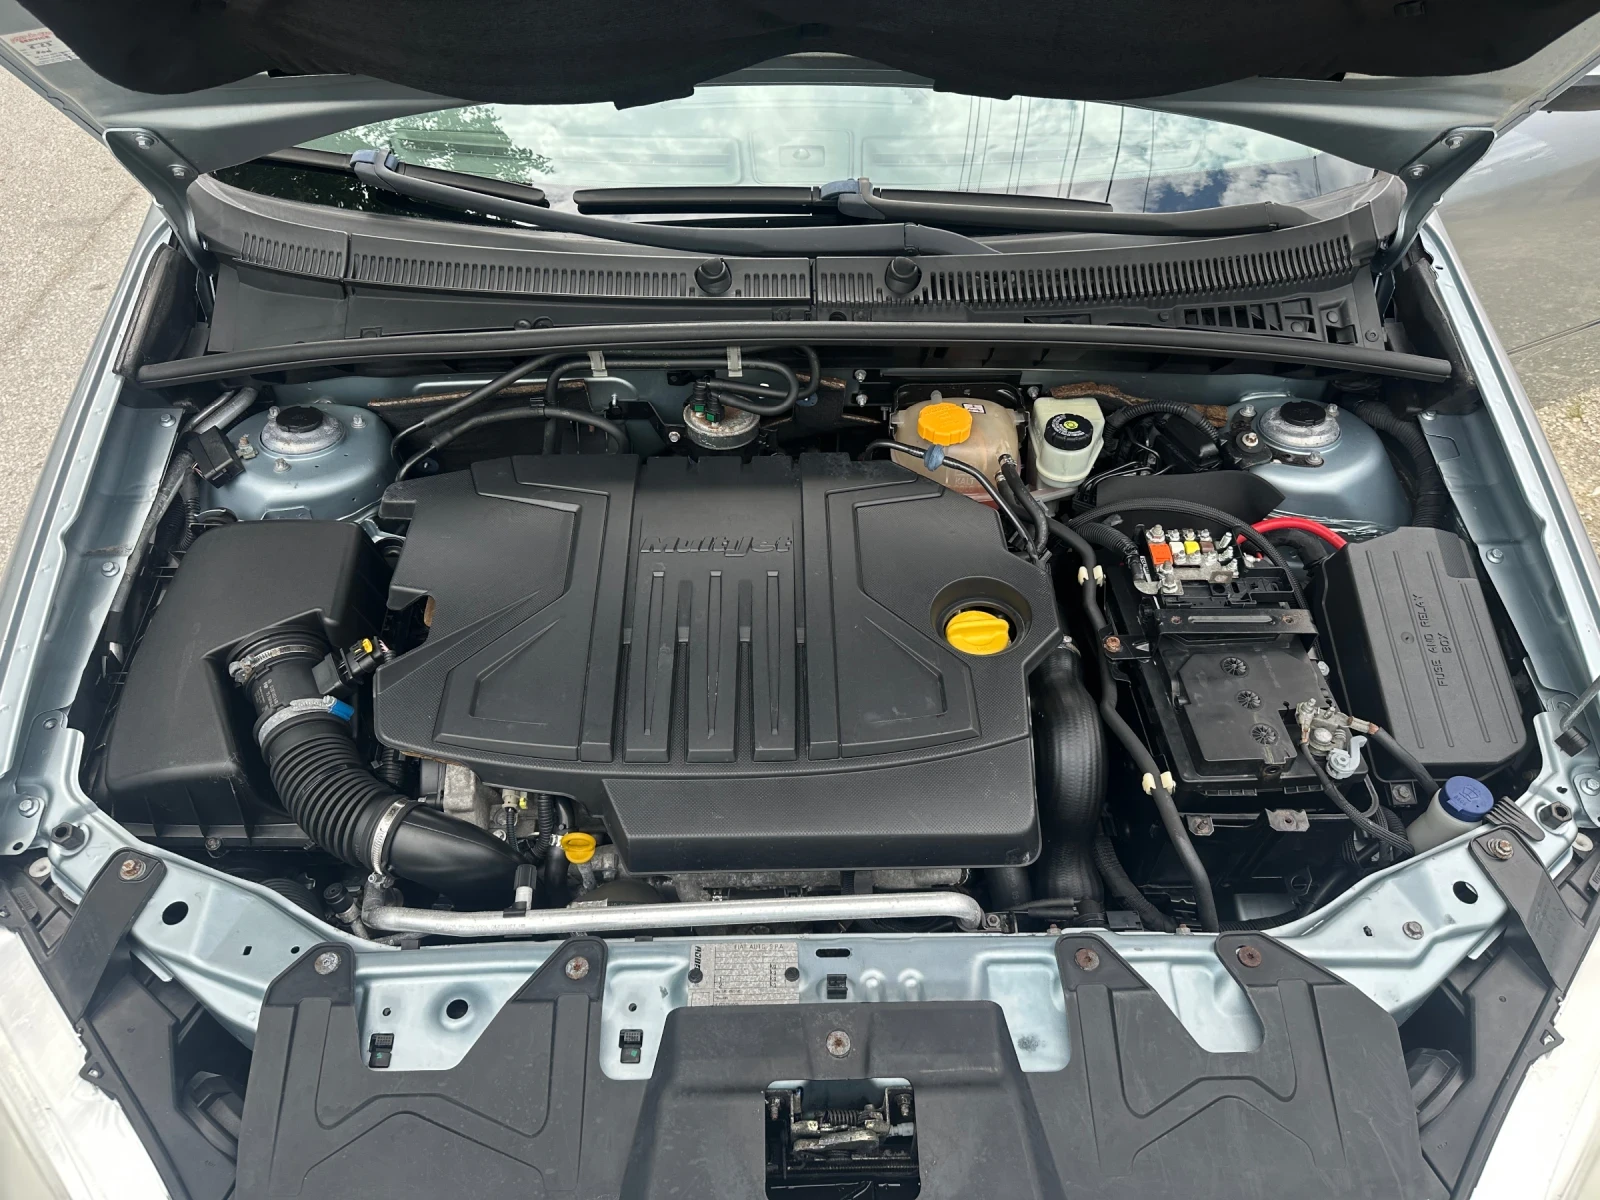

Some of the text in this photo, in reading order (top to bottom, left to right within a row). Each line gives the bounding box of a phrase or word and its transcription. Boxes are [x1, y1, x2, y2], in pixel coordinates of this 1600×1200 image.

[1412, 594, 1448, 687] FUSE AND RELAY
[1438, 632, 1452, 653] BOX
